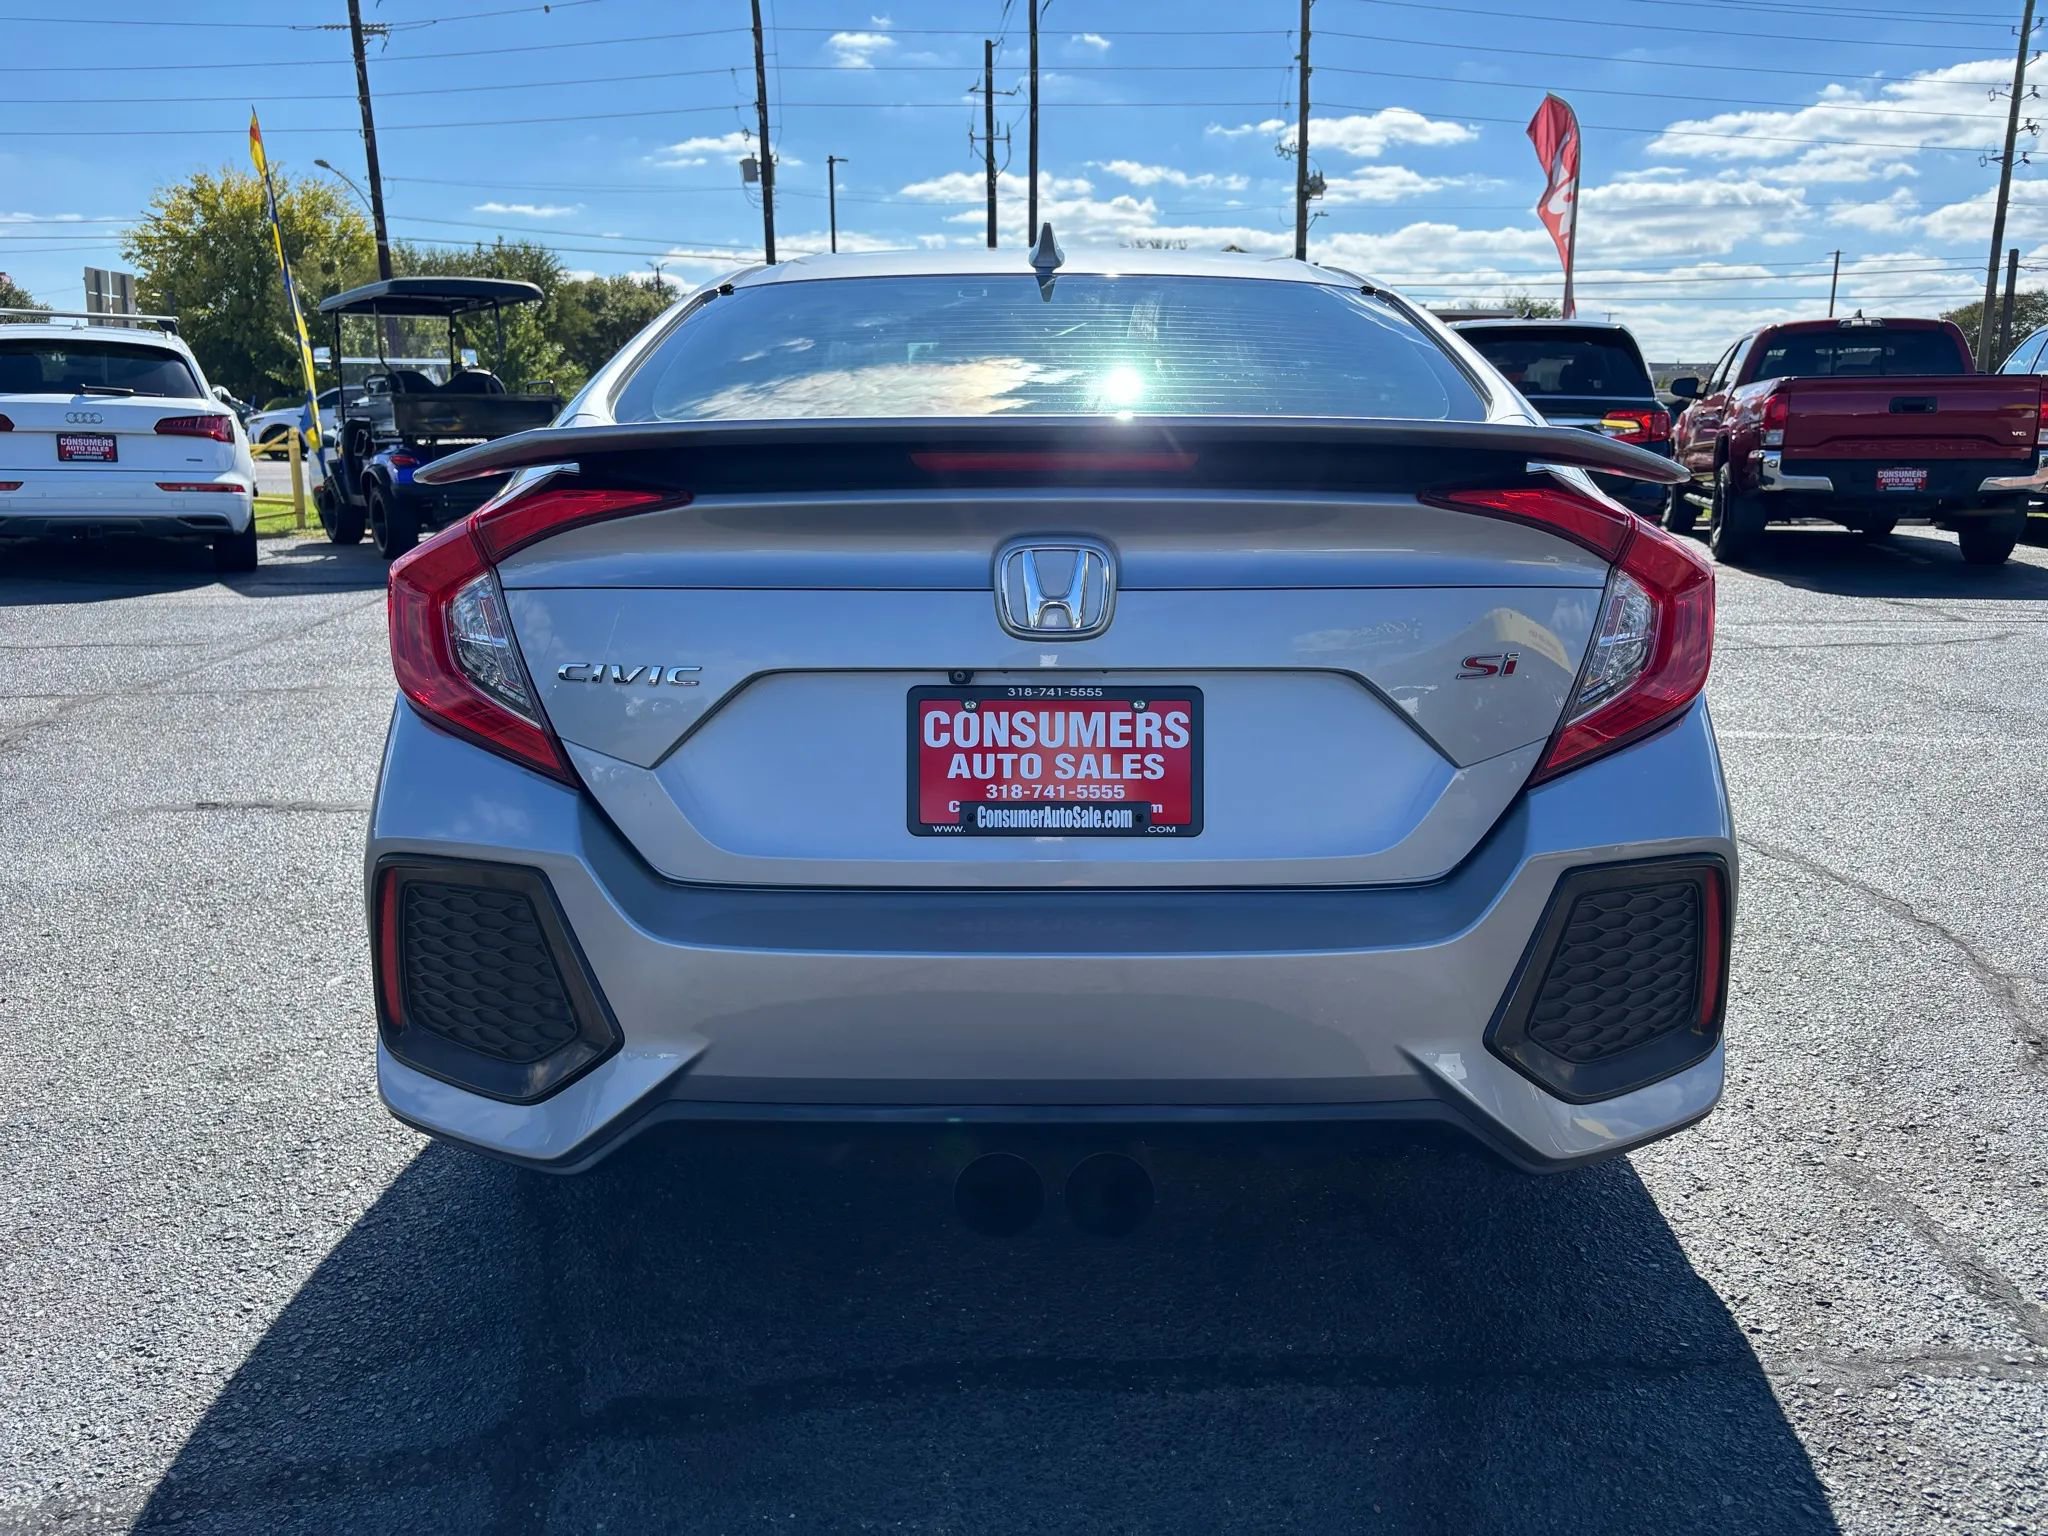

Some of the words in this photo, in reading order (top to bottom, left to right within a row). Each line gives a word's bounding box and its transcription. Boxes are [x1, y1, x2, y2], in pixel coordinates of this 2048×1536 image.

[60, 437, 114, 447] CONSUMERS
[1877, 470, 1928, 478] CONSUMERS
[557, 662, 703, 687] CIVIC
[1455, 652, 1521, 680] Si
[1007, 687, 1103, 697] 318-741-5555
[923, 710, 1191, 750] CONSUMERS
[946, 752, 1043, 780] AUTO
[1054, 752, 1166, 780] SALES
[985, 784, 1126, 800] 318-741-5555
[976, 804, 1134, 830] ConsumerAutoSale.com
